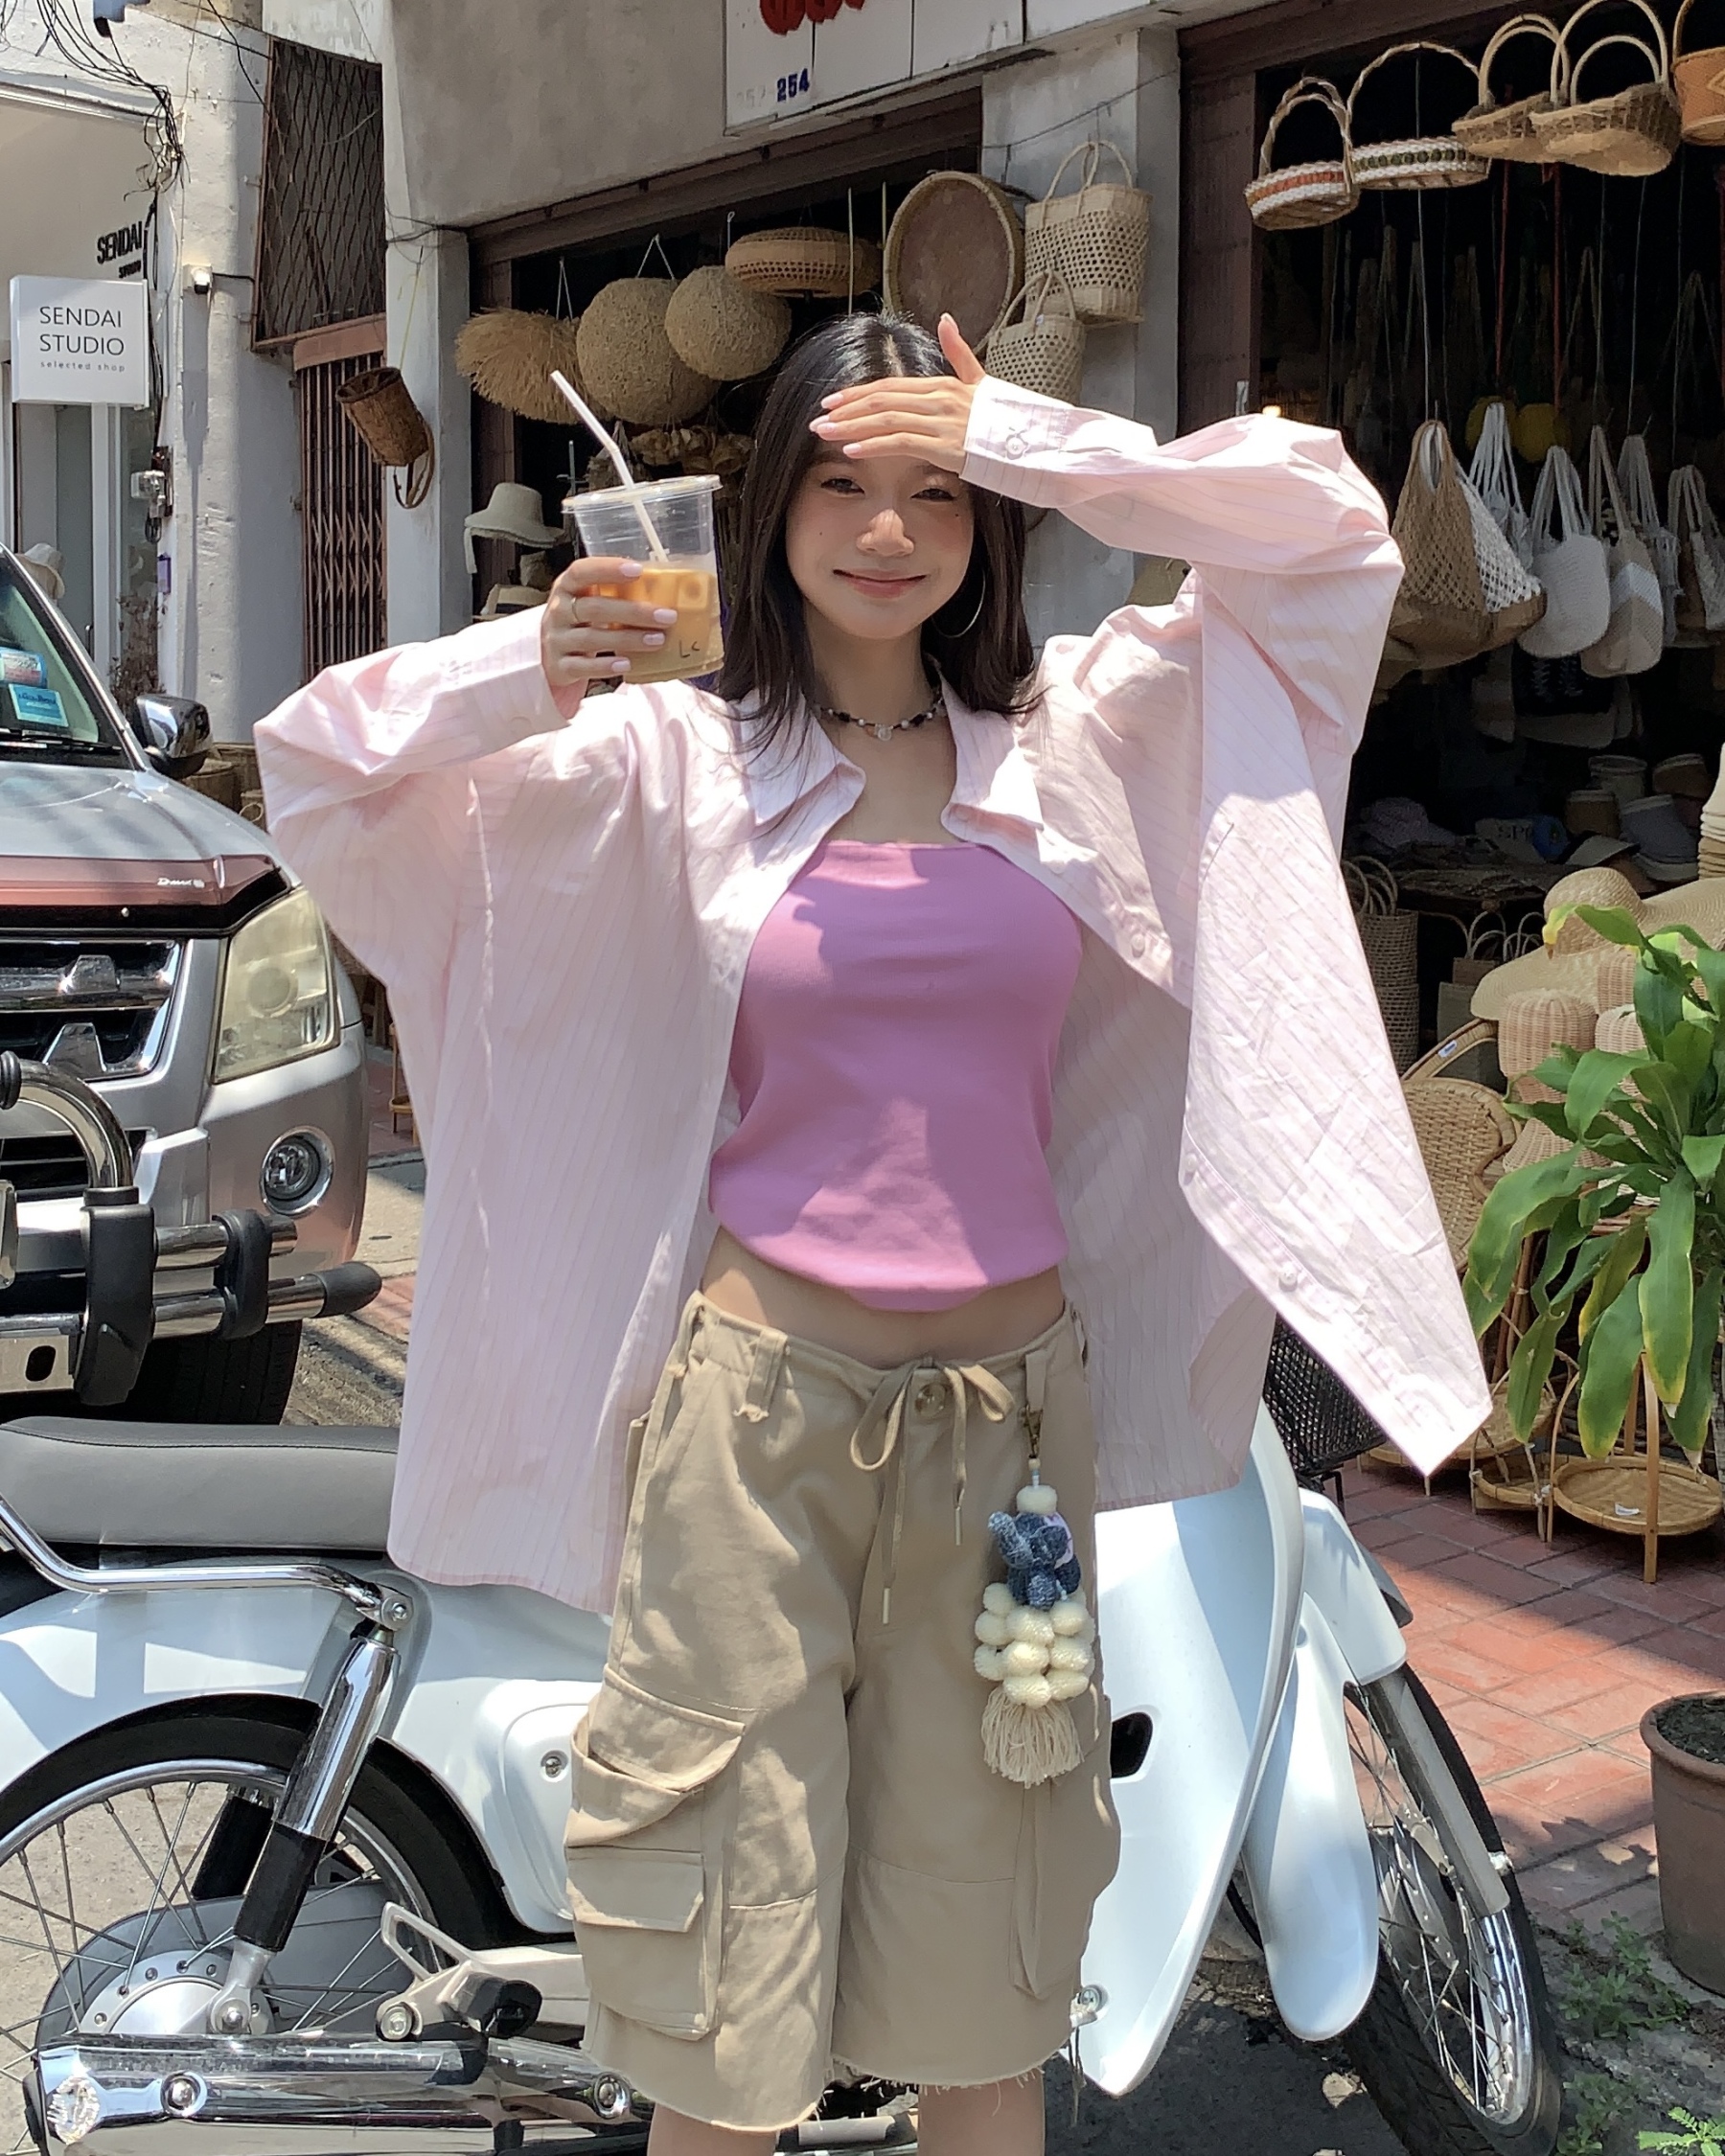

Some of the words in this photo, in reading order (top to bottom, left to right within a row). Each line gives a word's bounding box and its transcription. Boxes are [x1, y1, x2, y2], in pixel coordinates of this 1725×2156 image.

[777, 68, 810, 103] 254
[97, 220, 143, 265] SENDAI
[39, 306, 122, 328] SENDAI
[39, 333, 125, 356] STUDIO
[40, 360, 91, 371] selected
[98, 362, 126, 373] shop
